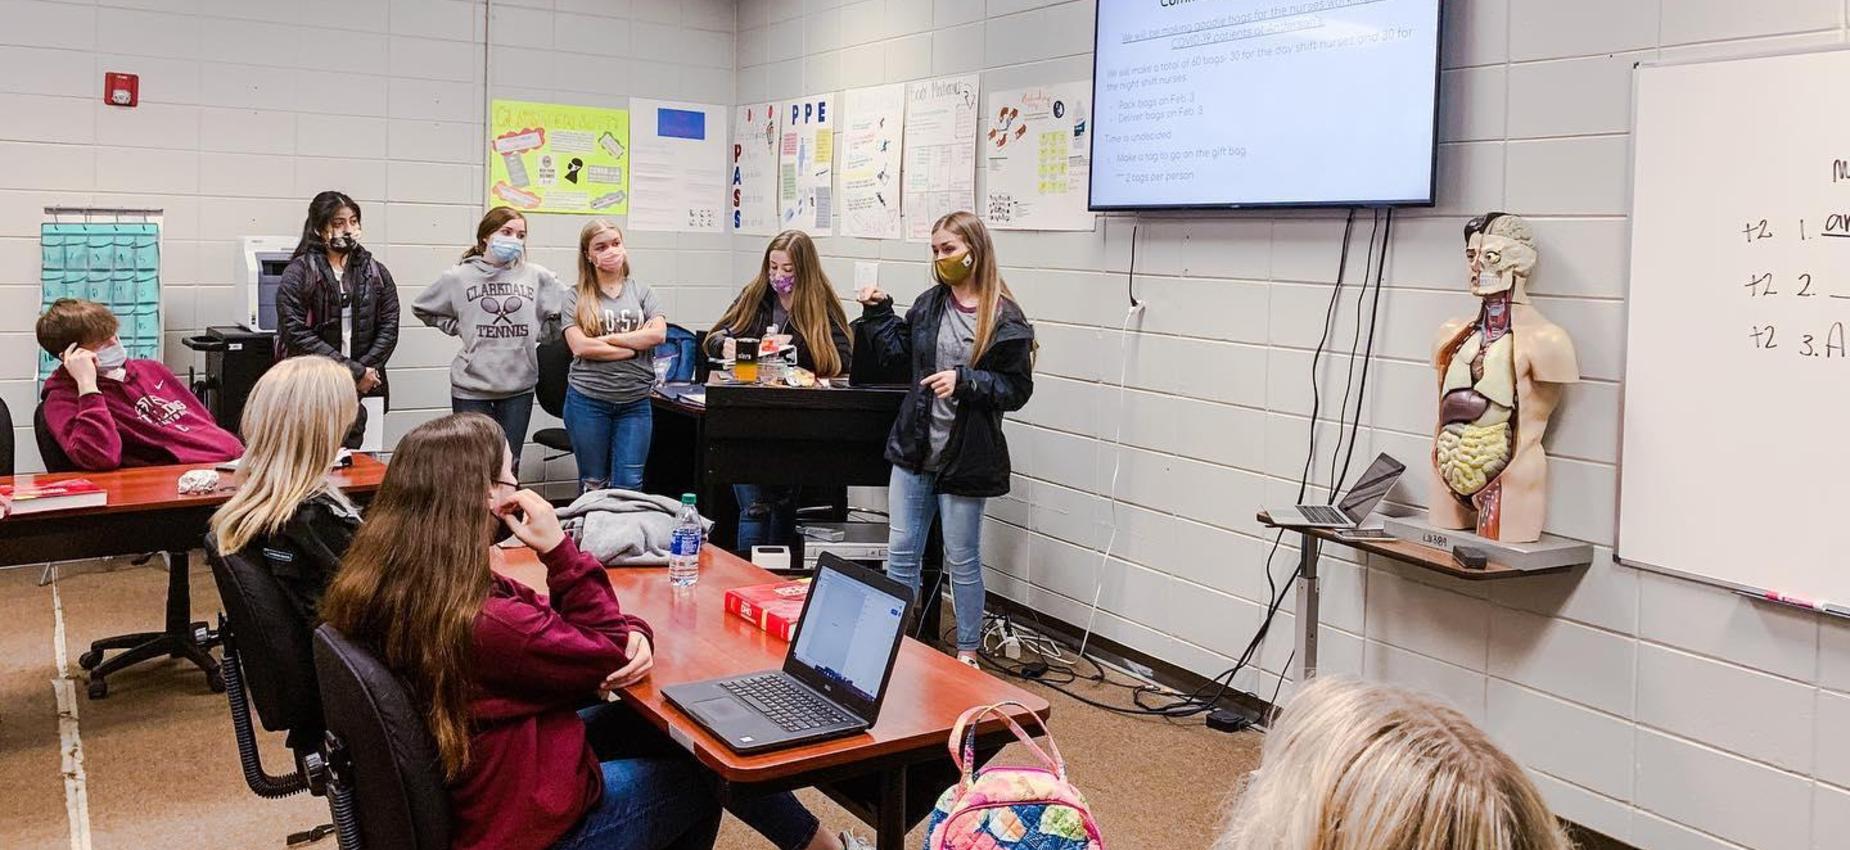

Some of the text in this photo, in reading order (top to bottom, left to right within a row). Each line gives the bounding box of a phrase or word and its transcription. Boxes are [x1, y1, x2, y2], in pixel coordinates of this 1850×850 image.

[1254, 8, 1269, 19] for
[1270, 5, 1287, 17] the
[1160, 60, 1180, 72] total
[1257, 46, 1273, 58] the
[1295, 40, 1317, 53] shift
[1319, 36, 1355, 49] nurses
[1357, 31, 1379, 44] and
[1397, 27, 1413, 39] for
[1119, 79, 1139, 92] night
[1136, 98, 1157, 109] bags
[791, 101, 826, 125] PPE
[1118, 112, 1143, 124] Deliver
[1145, 110, 1166, 122] bags
[1104, 133, 1122, 144] Time
[1116, 152, 1137, 163] Make
[1144, 151, 1158, 163] tag
[1195, 146, 1210, 158] the
[1211, 145, 1227, 160] gift
[1228, 145, 1247, 160] bag
[1150, 172, 1164, 183] per
[1165, 170, 1194, 184] person
[732, 143, 742, 229] PASS
[466, 283, 534, 302] CLARKDALE
[476, 324, 529, 338] TENNIS
